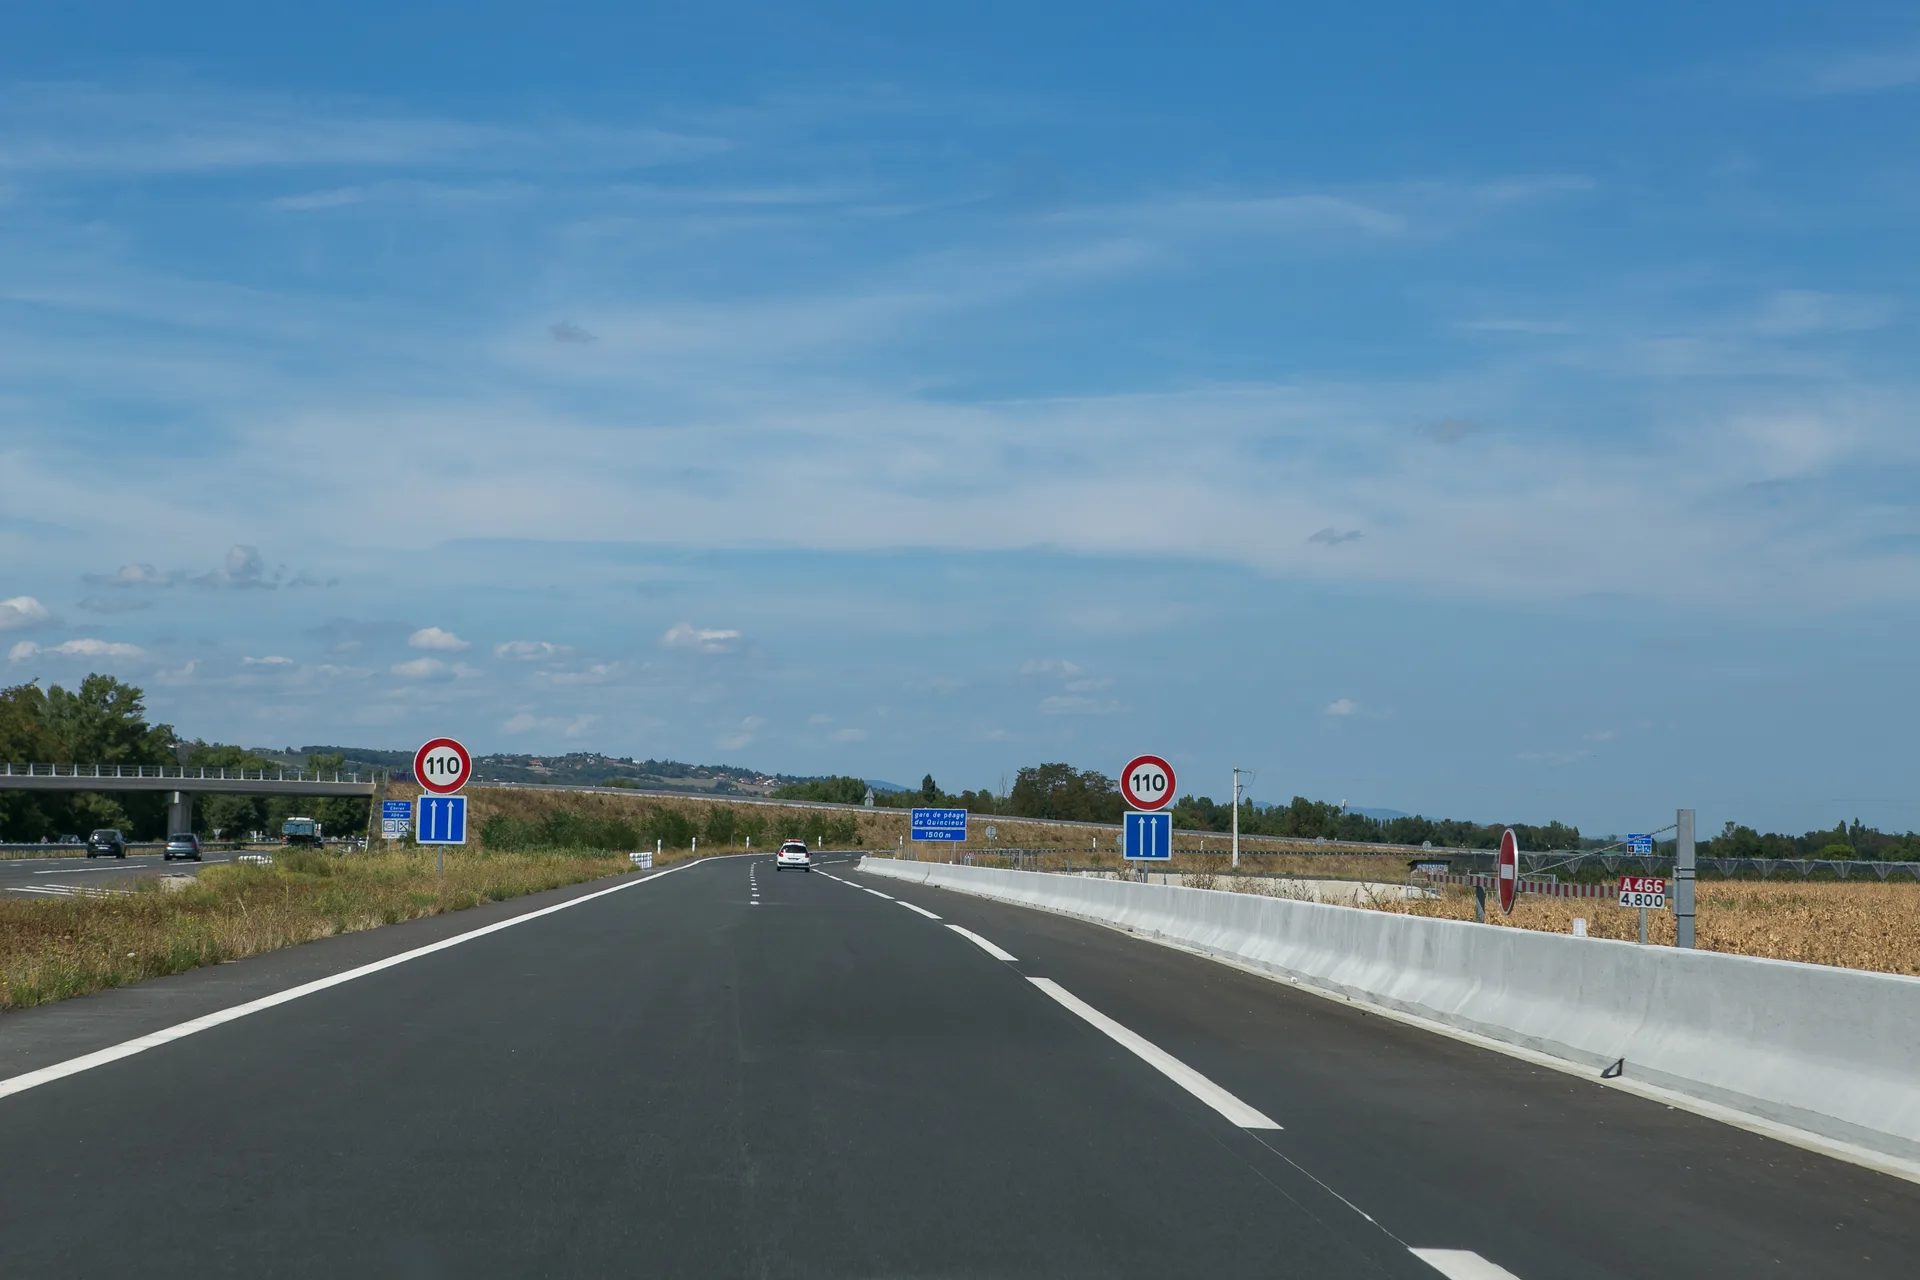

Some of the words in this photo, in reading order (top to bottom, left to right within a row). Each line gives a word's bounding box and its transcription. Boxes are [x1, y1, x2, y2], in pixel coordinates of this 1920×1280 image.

[426, 756, 460, 775] 110
[1132, 773, 1166, 792] 110
[914, 812, 930, 820] gare
[943, 811, 965, 820] péage
[925, 831, 944, 839] 1500
[1622, 878, 1632, 892] A
[1634, 878, 1663, 893] 466
[1621, 892, 1663, 908] 4,800
